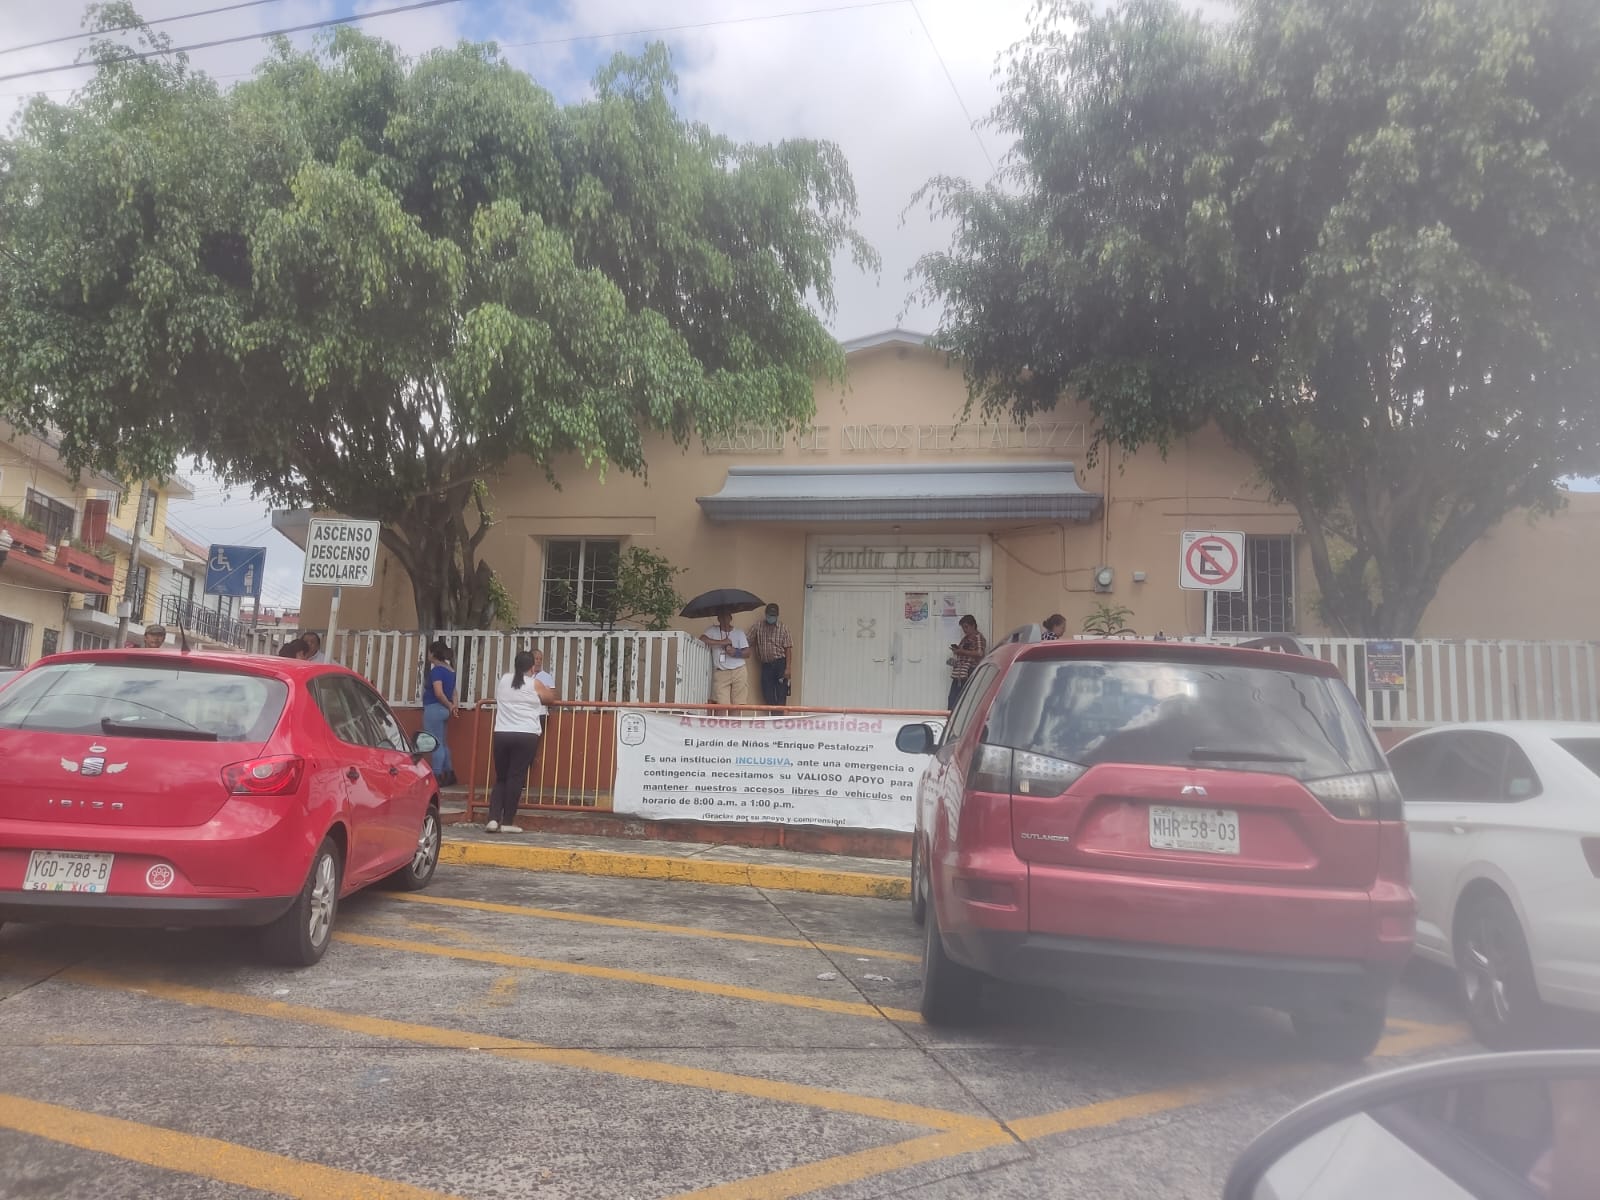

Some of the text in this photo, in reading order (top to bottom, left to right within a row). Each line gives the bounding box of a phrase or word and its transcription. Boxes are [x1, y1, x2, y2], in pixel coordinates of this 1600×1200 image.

[918, 423, 1085, 449] PESTALOZZI
[314, 526, 373, 542] ASCENSO
[311, 545, 370, 561] DESCENSO
[309, 563, 368, 580] ESCOLARES
[680, 717, 883, 733] A toda la comunidad
[684, 739, 693, 747] El
[727, 739, 739, 747] de
[742, 739, 769, 748] Niños
[644, 755, 656, 763] Es
[681, 755, 732, 764] institución
[735, 757, 793, 767] INCLUSIVA,
[797, 760, 819, 768] ante
[845, 763, 904, 772] emergencia
[644, 769, 706, 778] contingencia
[711, 771, 774, 779] necesitamos
[797, 773, 842, 782] VALIOSO
[848, 776, 885, 785] APOYO
[890, 779, 913, 788] para
[695, 784, 737, 792] nuestros
[791, 786, 819, 796] libres
[826, 788, 838, 796] de
[642, 797, 677, 805] horario
[679, 797, 691, 805] de
[693, 798, 714, 806] 8:00
[717, 799, 738, 807] a.m.
[751, 799, 771, 808] 1:00
[773, 801, 795, 810] p.m.
[1153, 816, 1236, 841] MHR-58-03
[1021, 832, 1070, 842] OUTLANDER
[34, 860, 108, 880] YGD-788-B
[55, 882, 97, 892] MXICO
